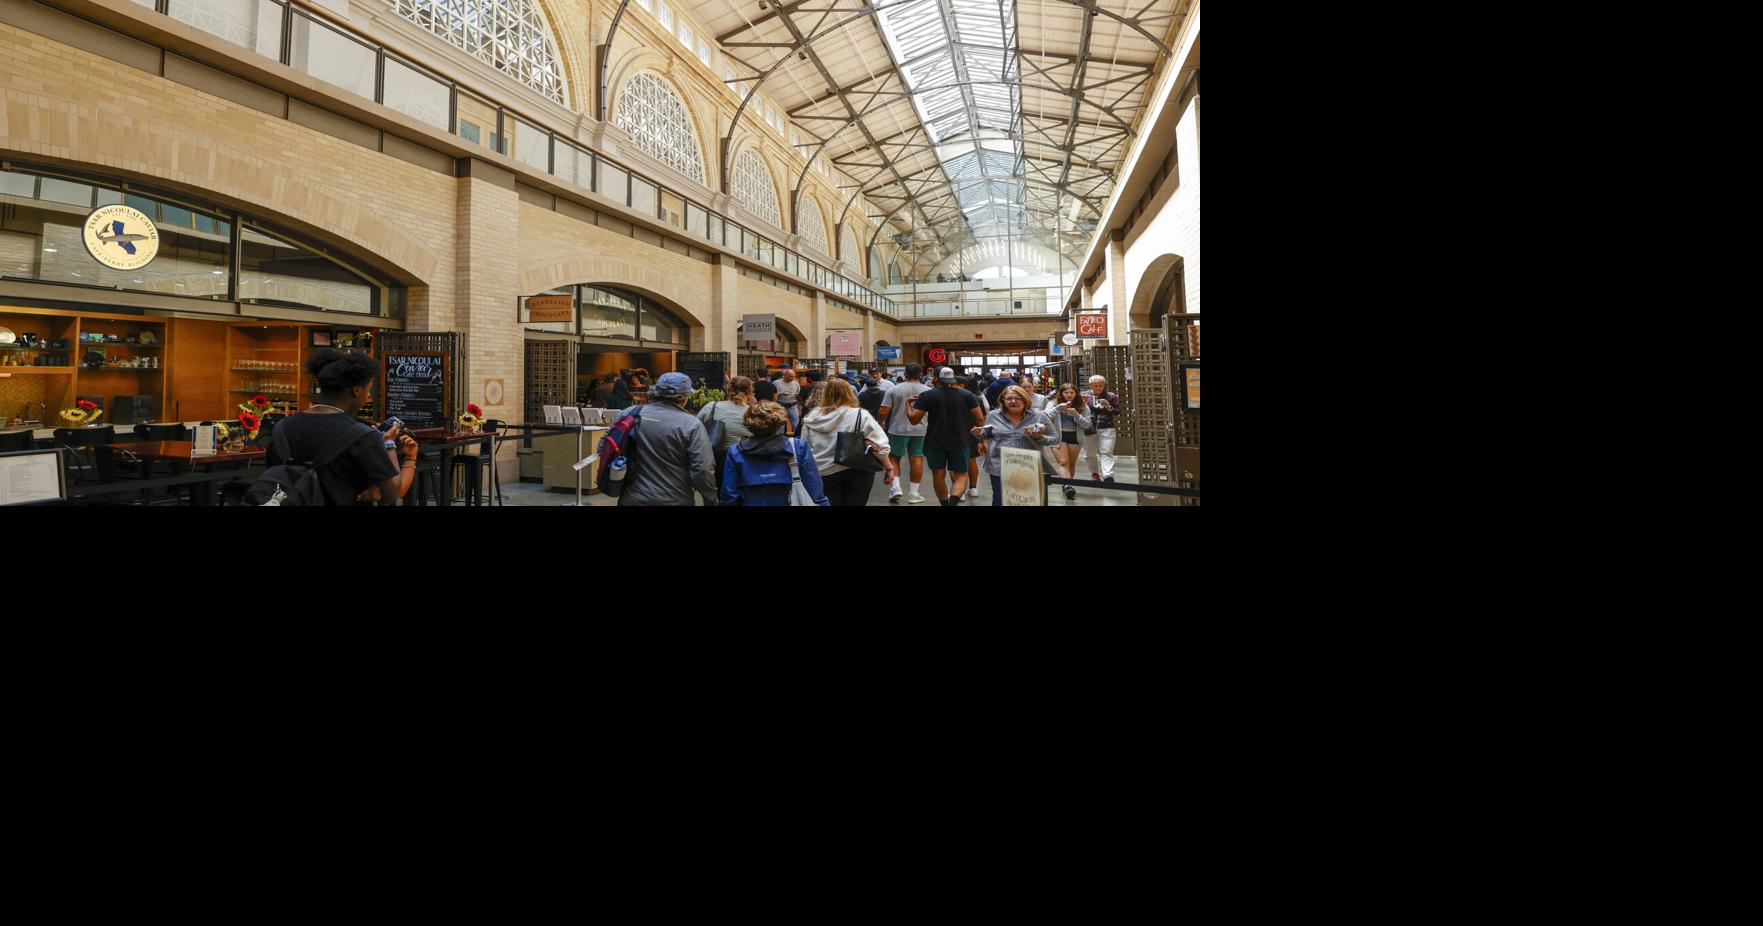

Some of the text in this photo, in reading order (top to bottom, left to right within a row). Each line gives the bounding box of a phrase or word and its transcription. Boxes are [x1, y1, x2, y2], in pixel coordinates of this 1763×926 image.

[88, 213, 102, 230] TSAR
[101, 207, 140, 219] NICOULAI
[140, 217, 157, 240] CAVIAR
[1080, 324, 1104, 335] CALF
[389, 356, 441, 365] TSAR NICOULAI
[929, 348, 945, 362] G
